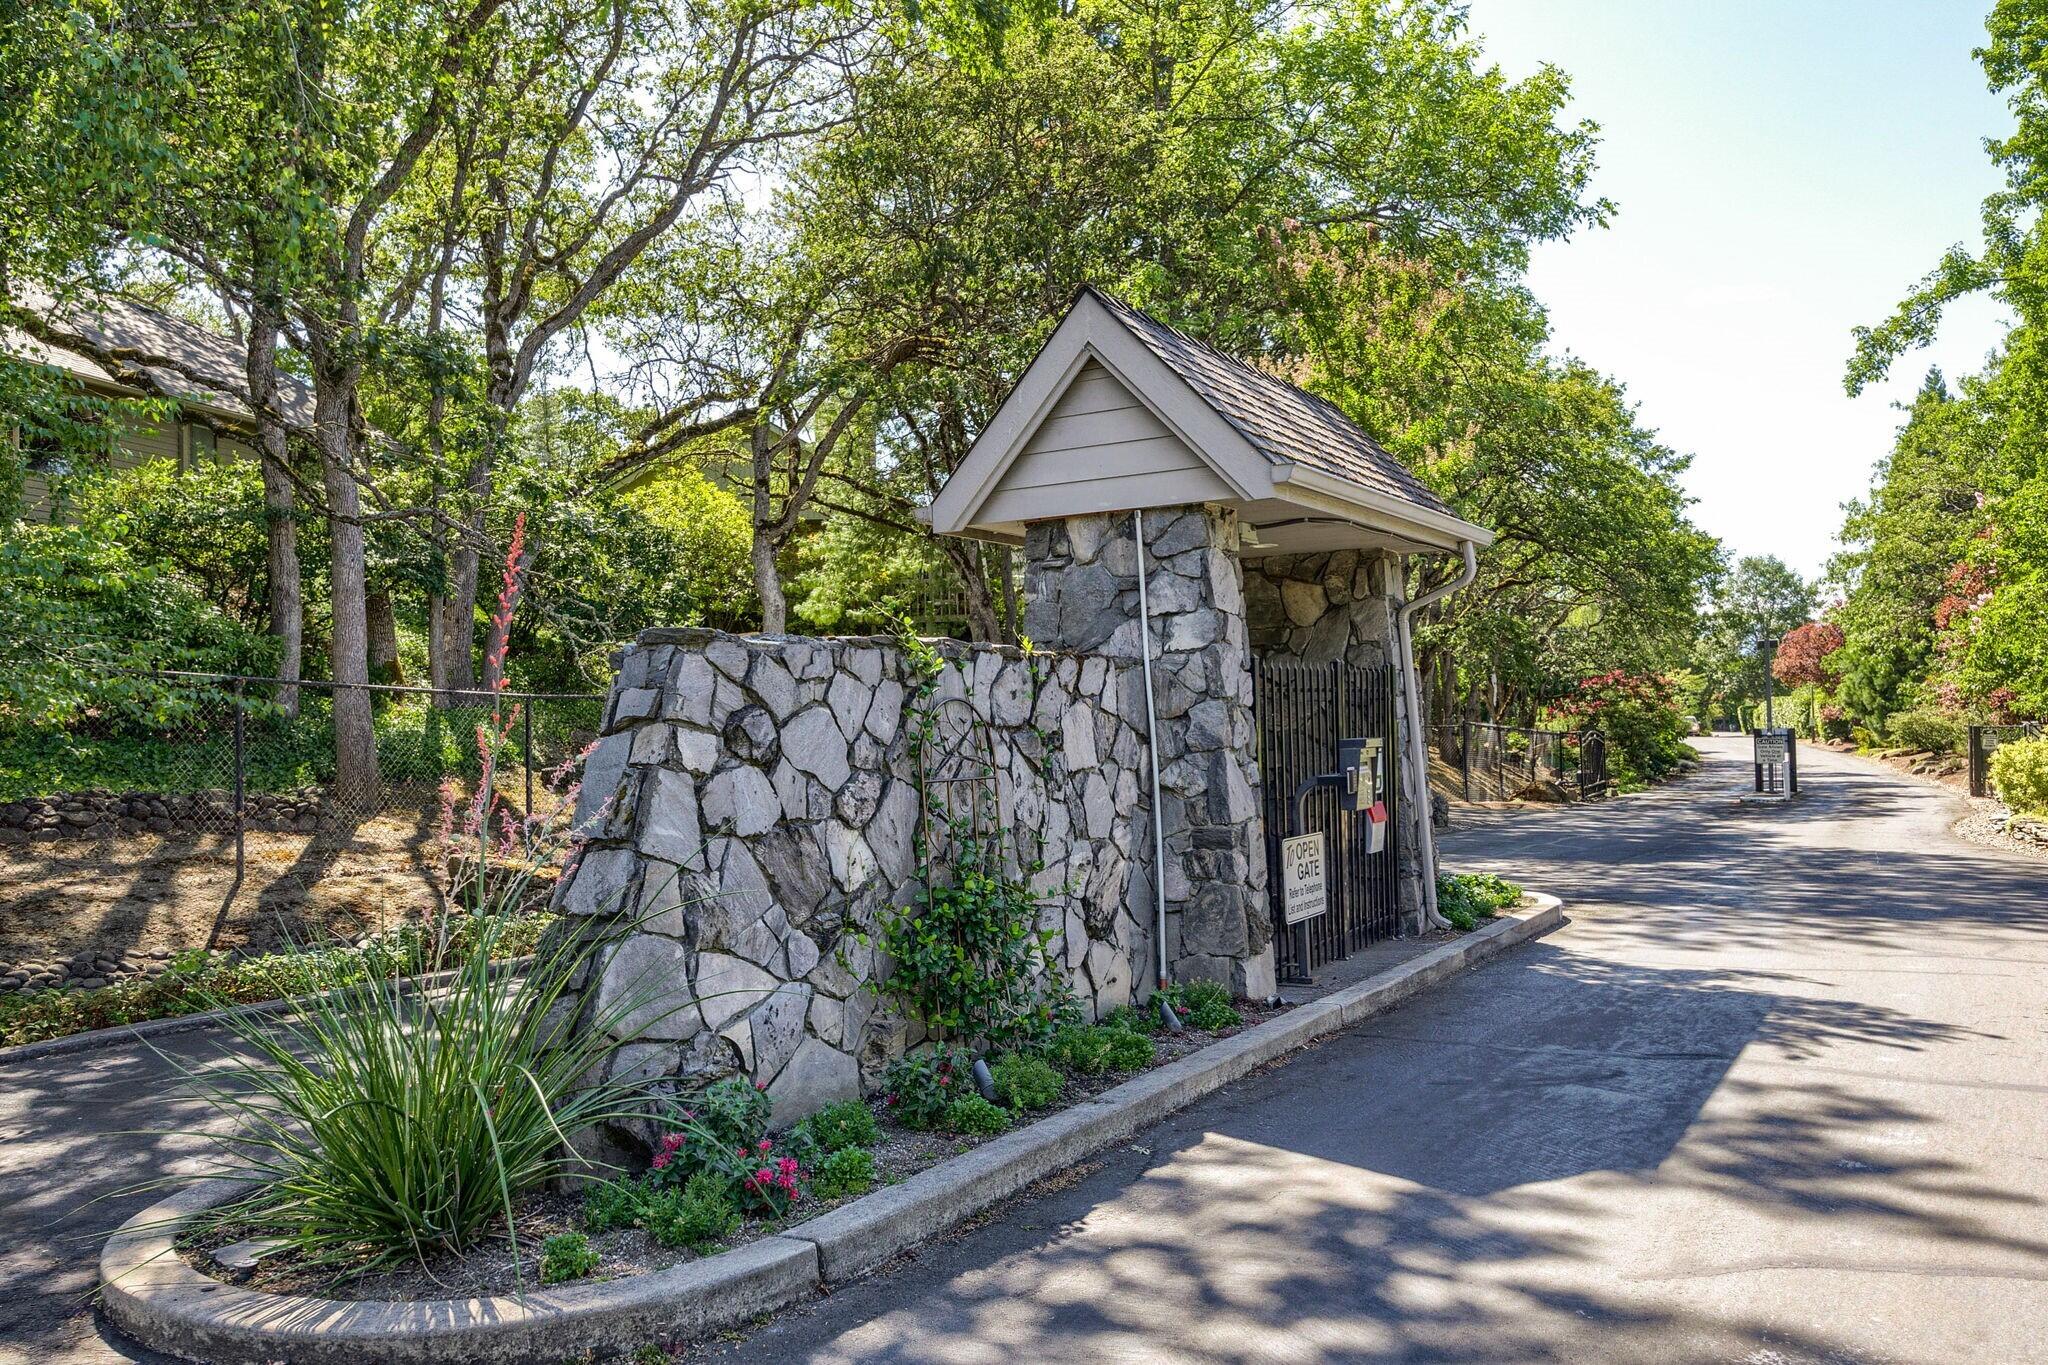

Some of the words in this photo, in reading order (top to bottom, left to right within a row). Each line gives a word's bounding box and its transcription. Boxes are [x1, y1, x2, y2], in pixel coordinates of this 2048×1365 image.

[1296, 839, 1319, 860] OPEN
[1298, 859, 1320, 880] GATE
[1289, 888, 1300, 900] Refer
[1300, 887, 1304, 896] to
[1304, 882, 1322, 896] Telephone
